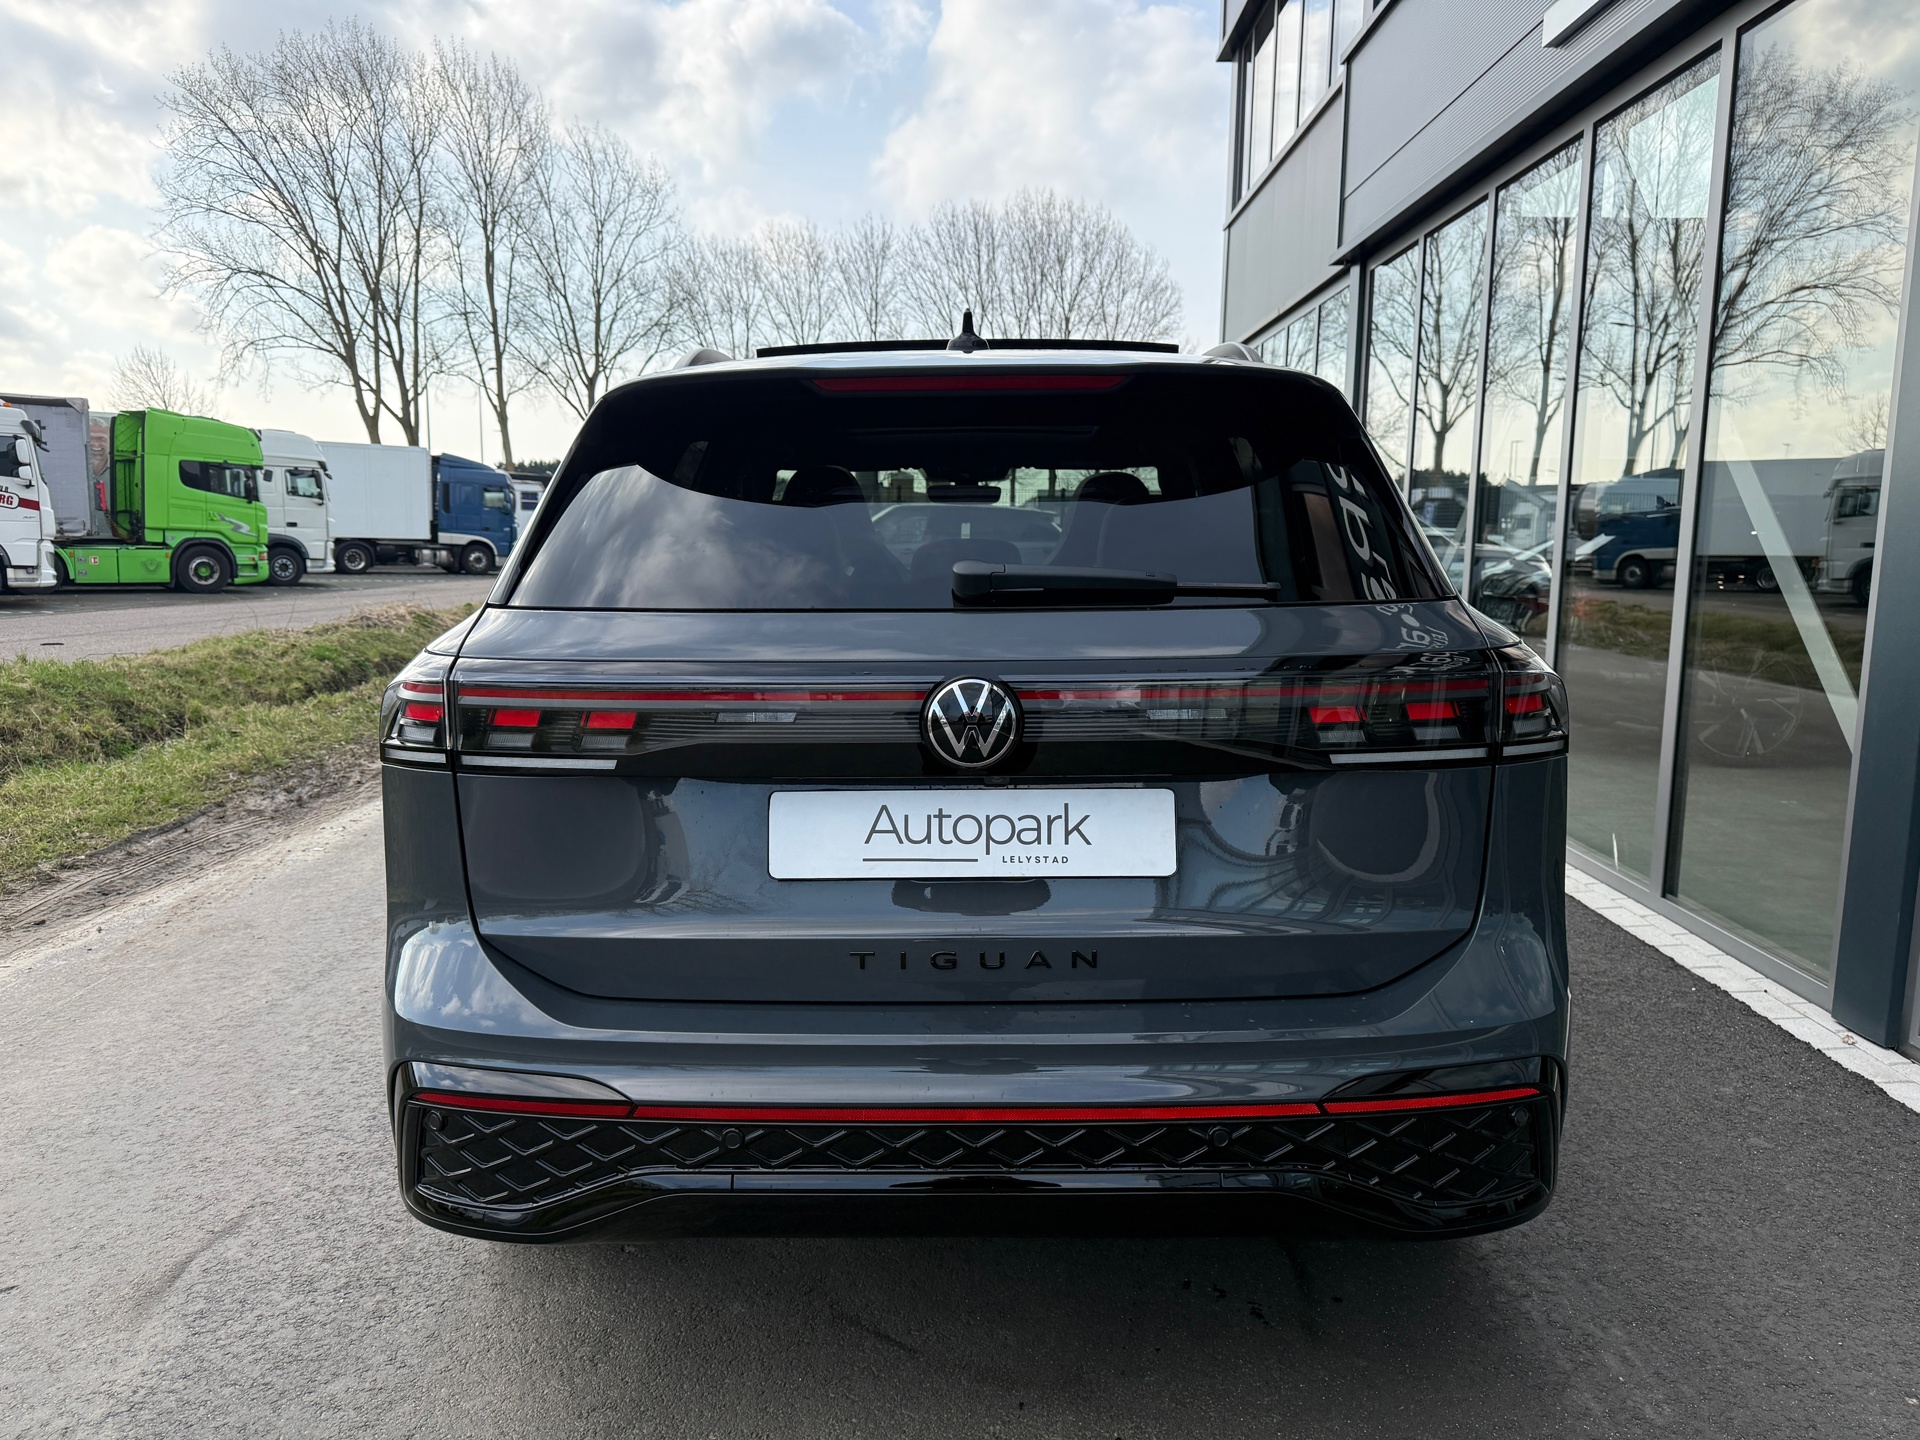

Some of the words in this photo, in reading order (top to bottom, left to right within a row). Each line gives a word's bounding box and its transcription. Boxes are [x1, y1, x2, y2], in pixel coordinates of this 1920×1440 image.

[864, 803, 1092, 856] Autopark
[1002, 855, 1069, 864] LELYSTAD
[849, 950, 1098, 970] TIGUAN
